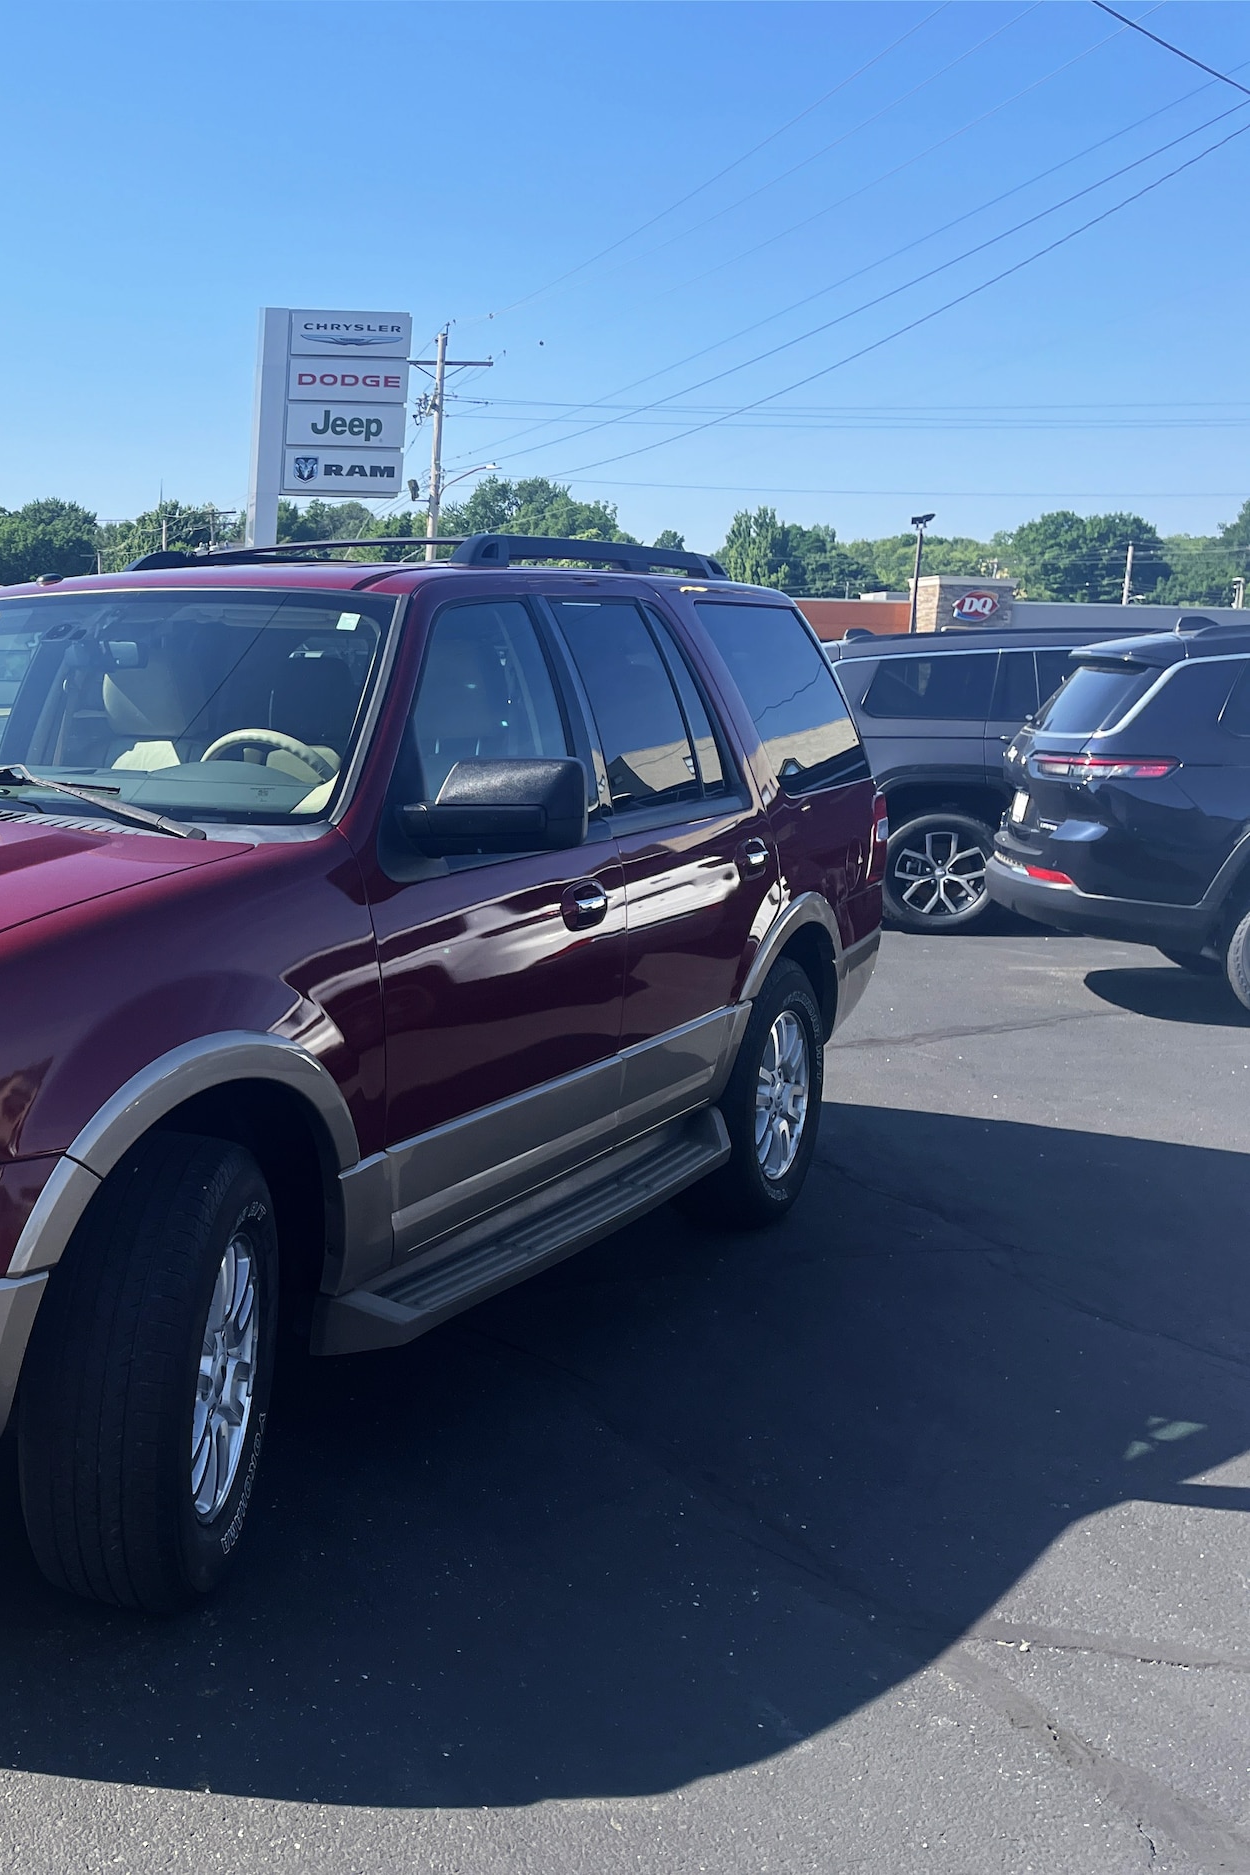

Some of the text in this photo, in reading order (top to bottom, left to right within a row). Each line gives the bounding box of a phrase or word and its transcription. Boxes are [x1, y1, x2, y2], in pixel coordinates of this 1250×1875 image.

[304, 323, 401, 333] CHRYSLER
[298, 373, 400, 388] DODGE
[311, 410, 382, 441] Jeep
[324, 464, 395, 478] RAM
[962, 597, 993, 615] DQ
[220, 1412, 267, 1555] YOKOHAMA
